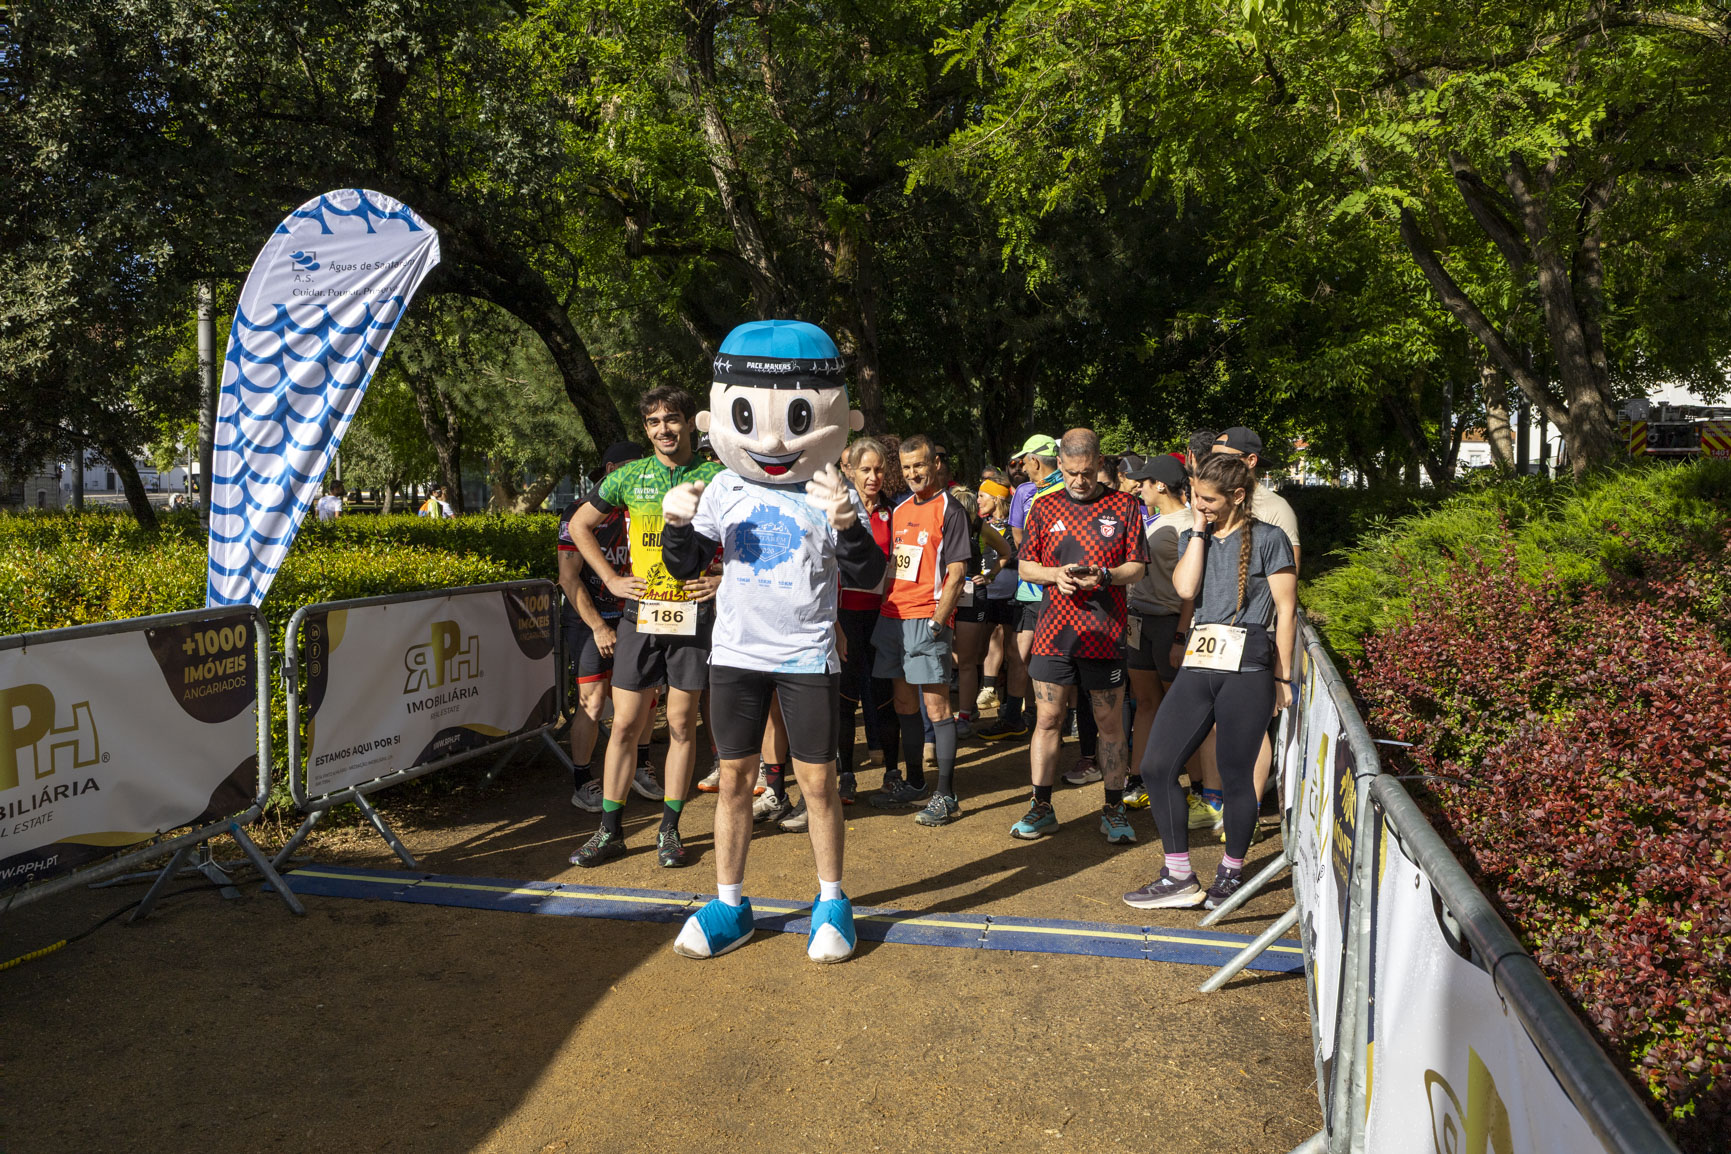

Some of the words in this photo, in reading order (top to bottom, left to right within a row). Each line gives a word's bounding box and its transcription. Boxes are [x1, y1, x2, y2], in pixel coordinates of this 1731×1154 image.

[293, 274, 315, 283] A.S.
[329, 260, 357, 273] Águas
[360, 262, 371, 270] de
[746, 361, 763, 369] PACE
[764, 362, 791, 370] MAKERS
[651, 609, 684, 623] 186
[183, 624, 247, 656] +1000
[1195, 636, 1227, 655] 207
[184, 654, 247, 684] IMÓVEIS
[183, 675, 247, 700] ANGARIADOS
[407, 686, 479, 714] IMOBILIÁRIA
[315, 747, 351, 767] ESTAMOS
[352, 742, 373, 756] AQUI
[374, 737, 393, 750] POR
[394, 734, 401, 745] SI
[13, 810, 54, 835] ESTATE
[0, 855, 59, 880] W.RPH.PT
